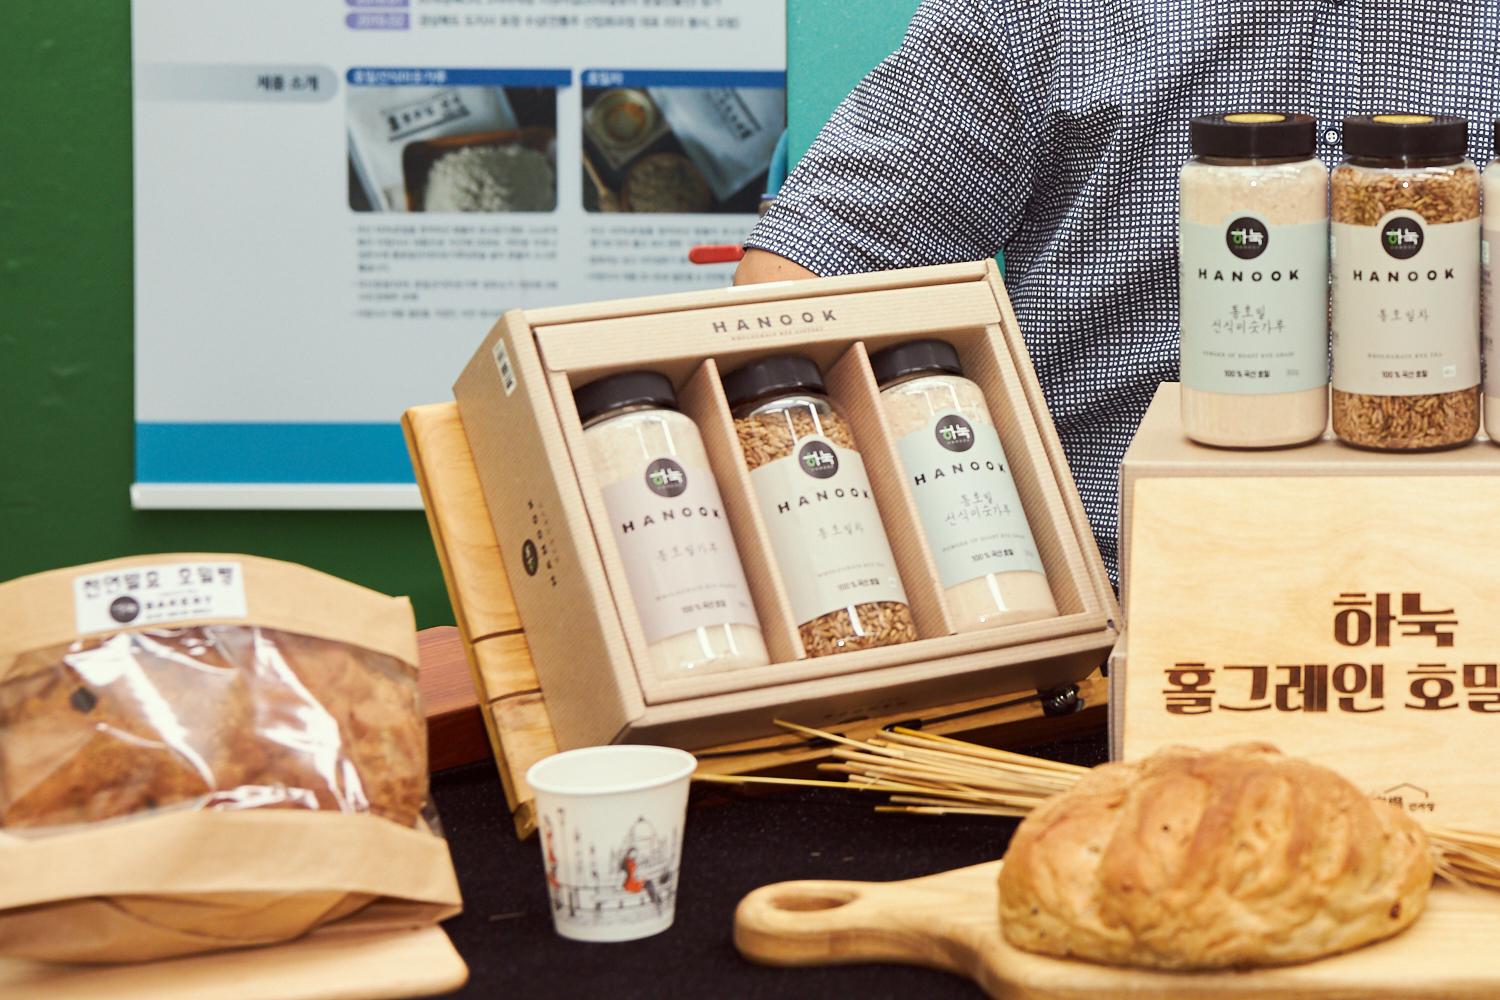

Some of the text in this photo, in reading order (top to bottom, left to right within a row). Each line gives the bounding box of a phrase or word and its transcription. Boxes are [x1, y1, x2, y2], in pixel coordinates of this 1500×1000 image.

[1198, 268, 1299, 282] HANOOK
[1353, 268, 1454, 282] HANOOK
[712, 309, 836, 333] HANOOK
[914, 461, 1006, 486] HANOOK
[778, 488, 870, 513] HANOOK
[622, 507, 721, 533] HANOOK
[1333, 592, 1459, 648] 하눅
[1162, 662, 1385, 714] 홀그레인
